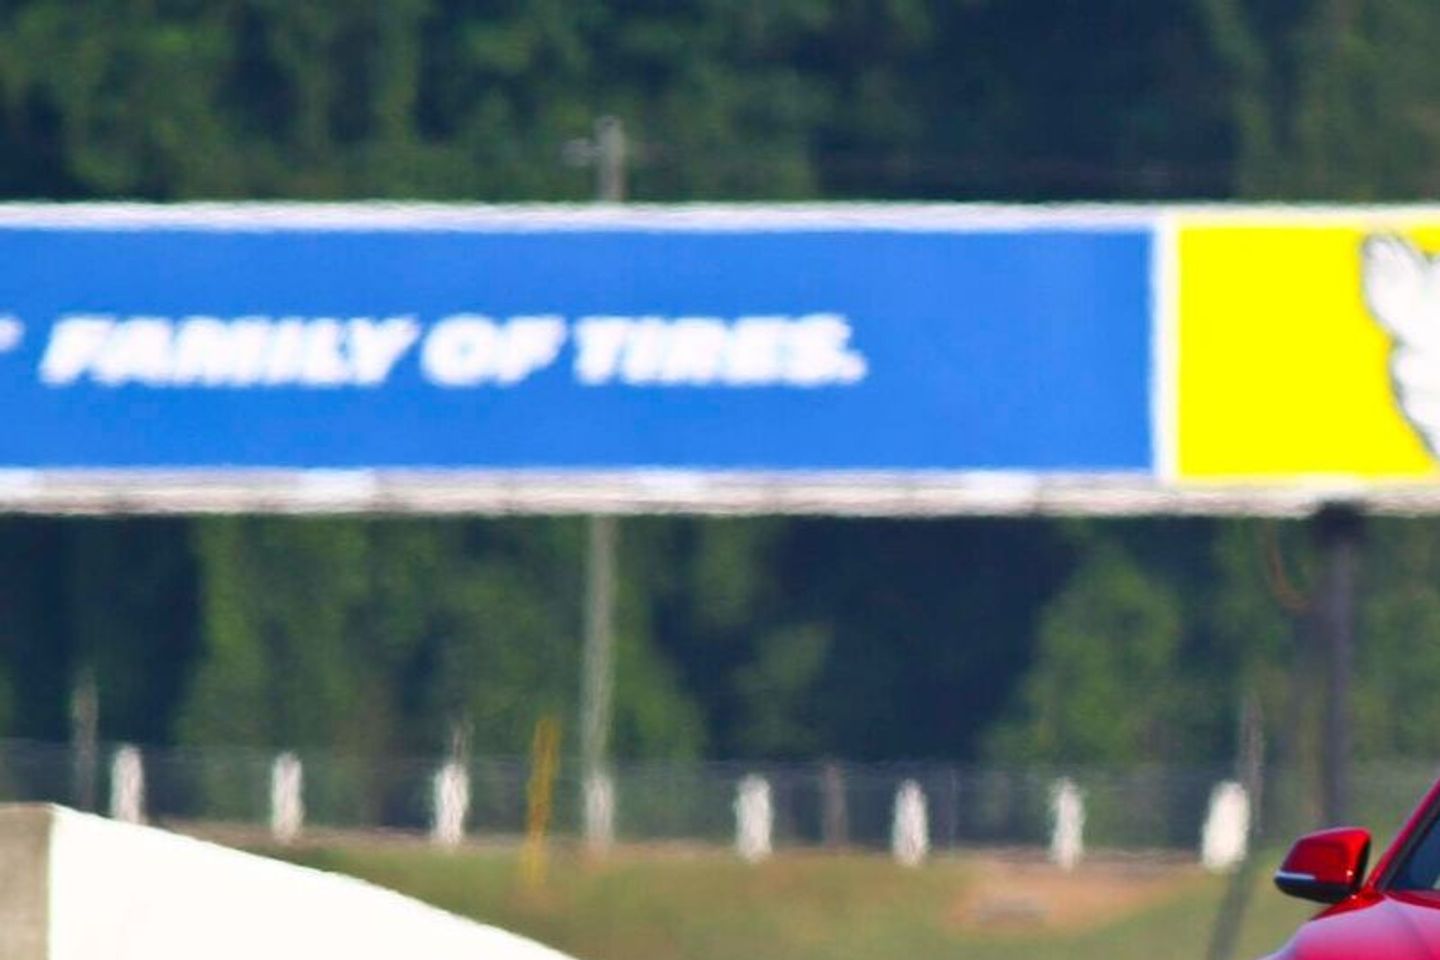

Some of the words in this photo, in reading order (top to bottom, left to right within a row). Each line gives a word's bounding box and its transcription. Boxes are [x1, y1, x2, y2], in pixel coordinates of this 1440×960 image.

[40, 314, 419, 386] FAMILY
[421, 314, 567, 386] OF
[573, 314, 866, 386] TIRES.
